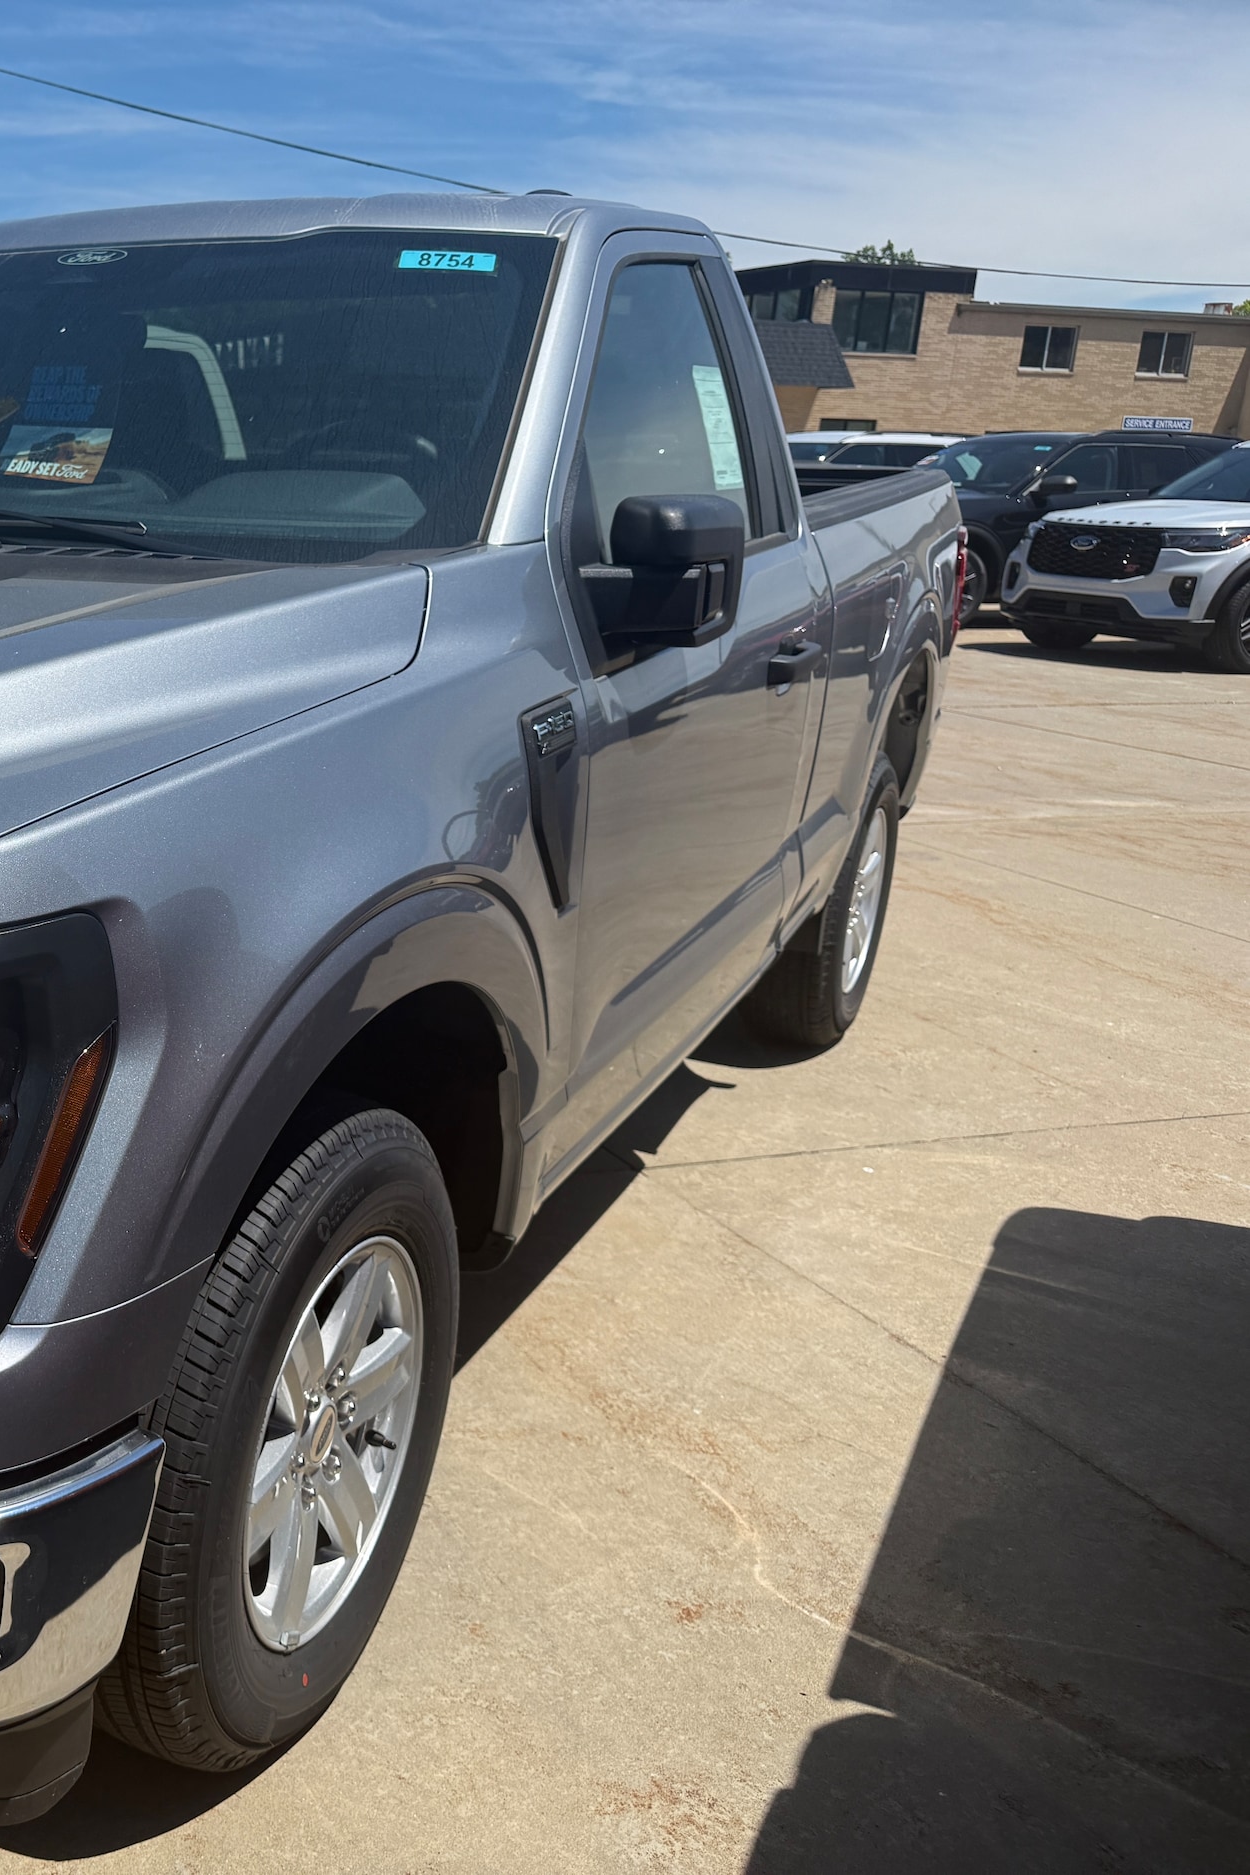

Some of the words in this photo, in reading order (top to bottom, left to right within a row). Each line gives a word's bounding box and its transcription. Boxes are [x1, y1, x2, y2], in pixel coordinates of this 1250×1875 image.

[67, 251, 117, 263] Ford
[418, 252, 474, 268] 8754
[24, 404, 95, 421] OWNERSHIP
[1125, 418, 1154, 428] SERVICE
[1155, 419, 1191, 430] ENTRANCE
[36, 461, 61, 477] SET
[55, 463, 90, 480] Ford
